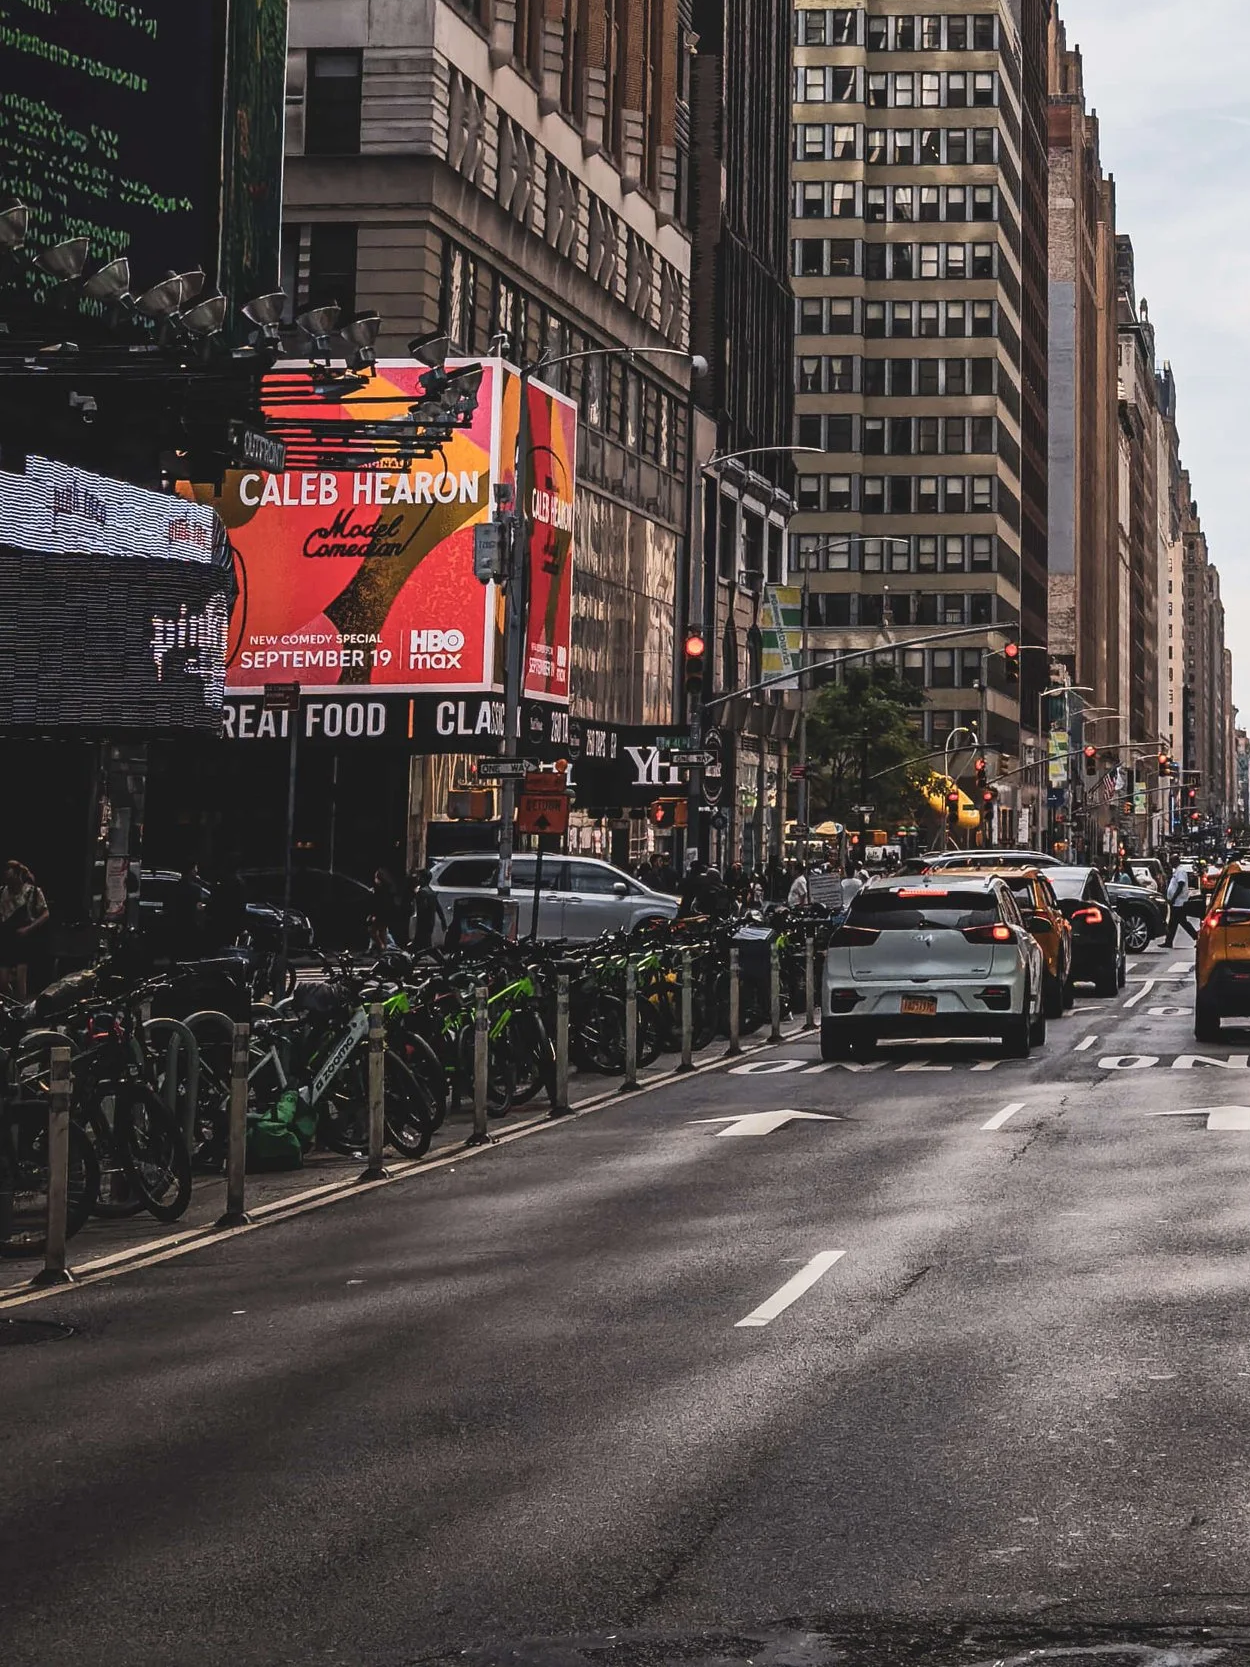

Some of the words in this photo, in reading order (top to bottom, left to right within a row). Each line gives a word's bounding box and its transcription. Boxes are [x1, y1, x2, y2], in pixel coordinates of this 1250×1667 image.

[239, 471, 339, 506] CALEB
[353, 470, 479, 505] HEARON
[318, 508, 404, 540] Model
[302, 528, 406, 559] Comedian
[249, 634, 278, 645] NEW
[281, 634, 333, 645] COMEDY
[335, 633, 383, 644] SPECIAL
[409, 628, 464, 653] HBO
[240, 649, 364, 670] SEPTEMBER
[371, 649, 392, 667] 19
[409, 652, 462, 670] max
[306, 703, 386, 738] FOOD
[481, 764, 501, 774] ONE
[511, 763, 531, 774] WAY
